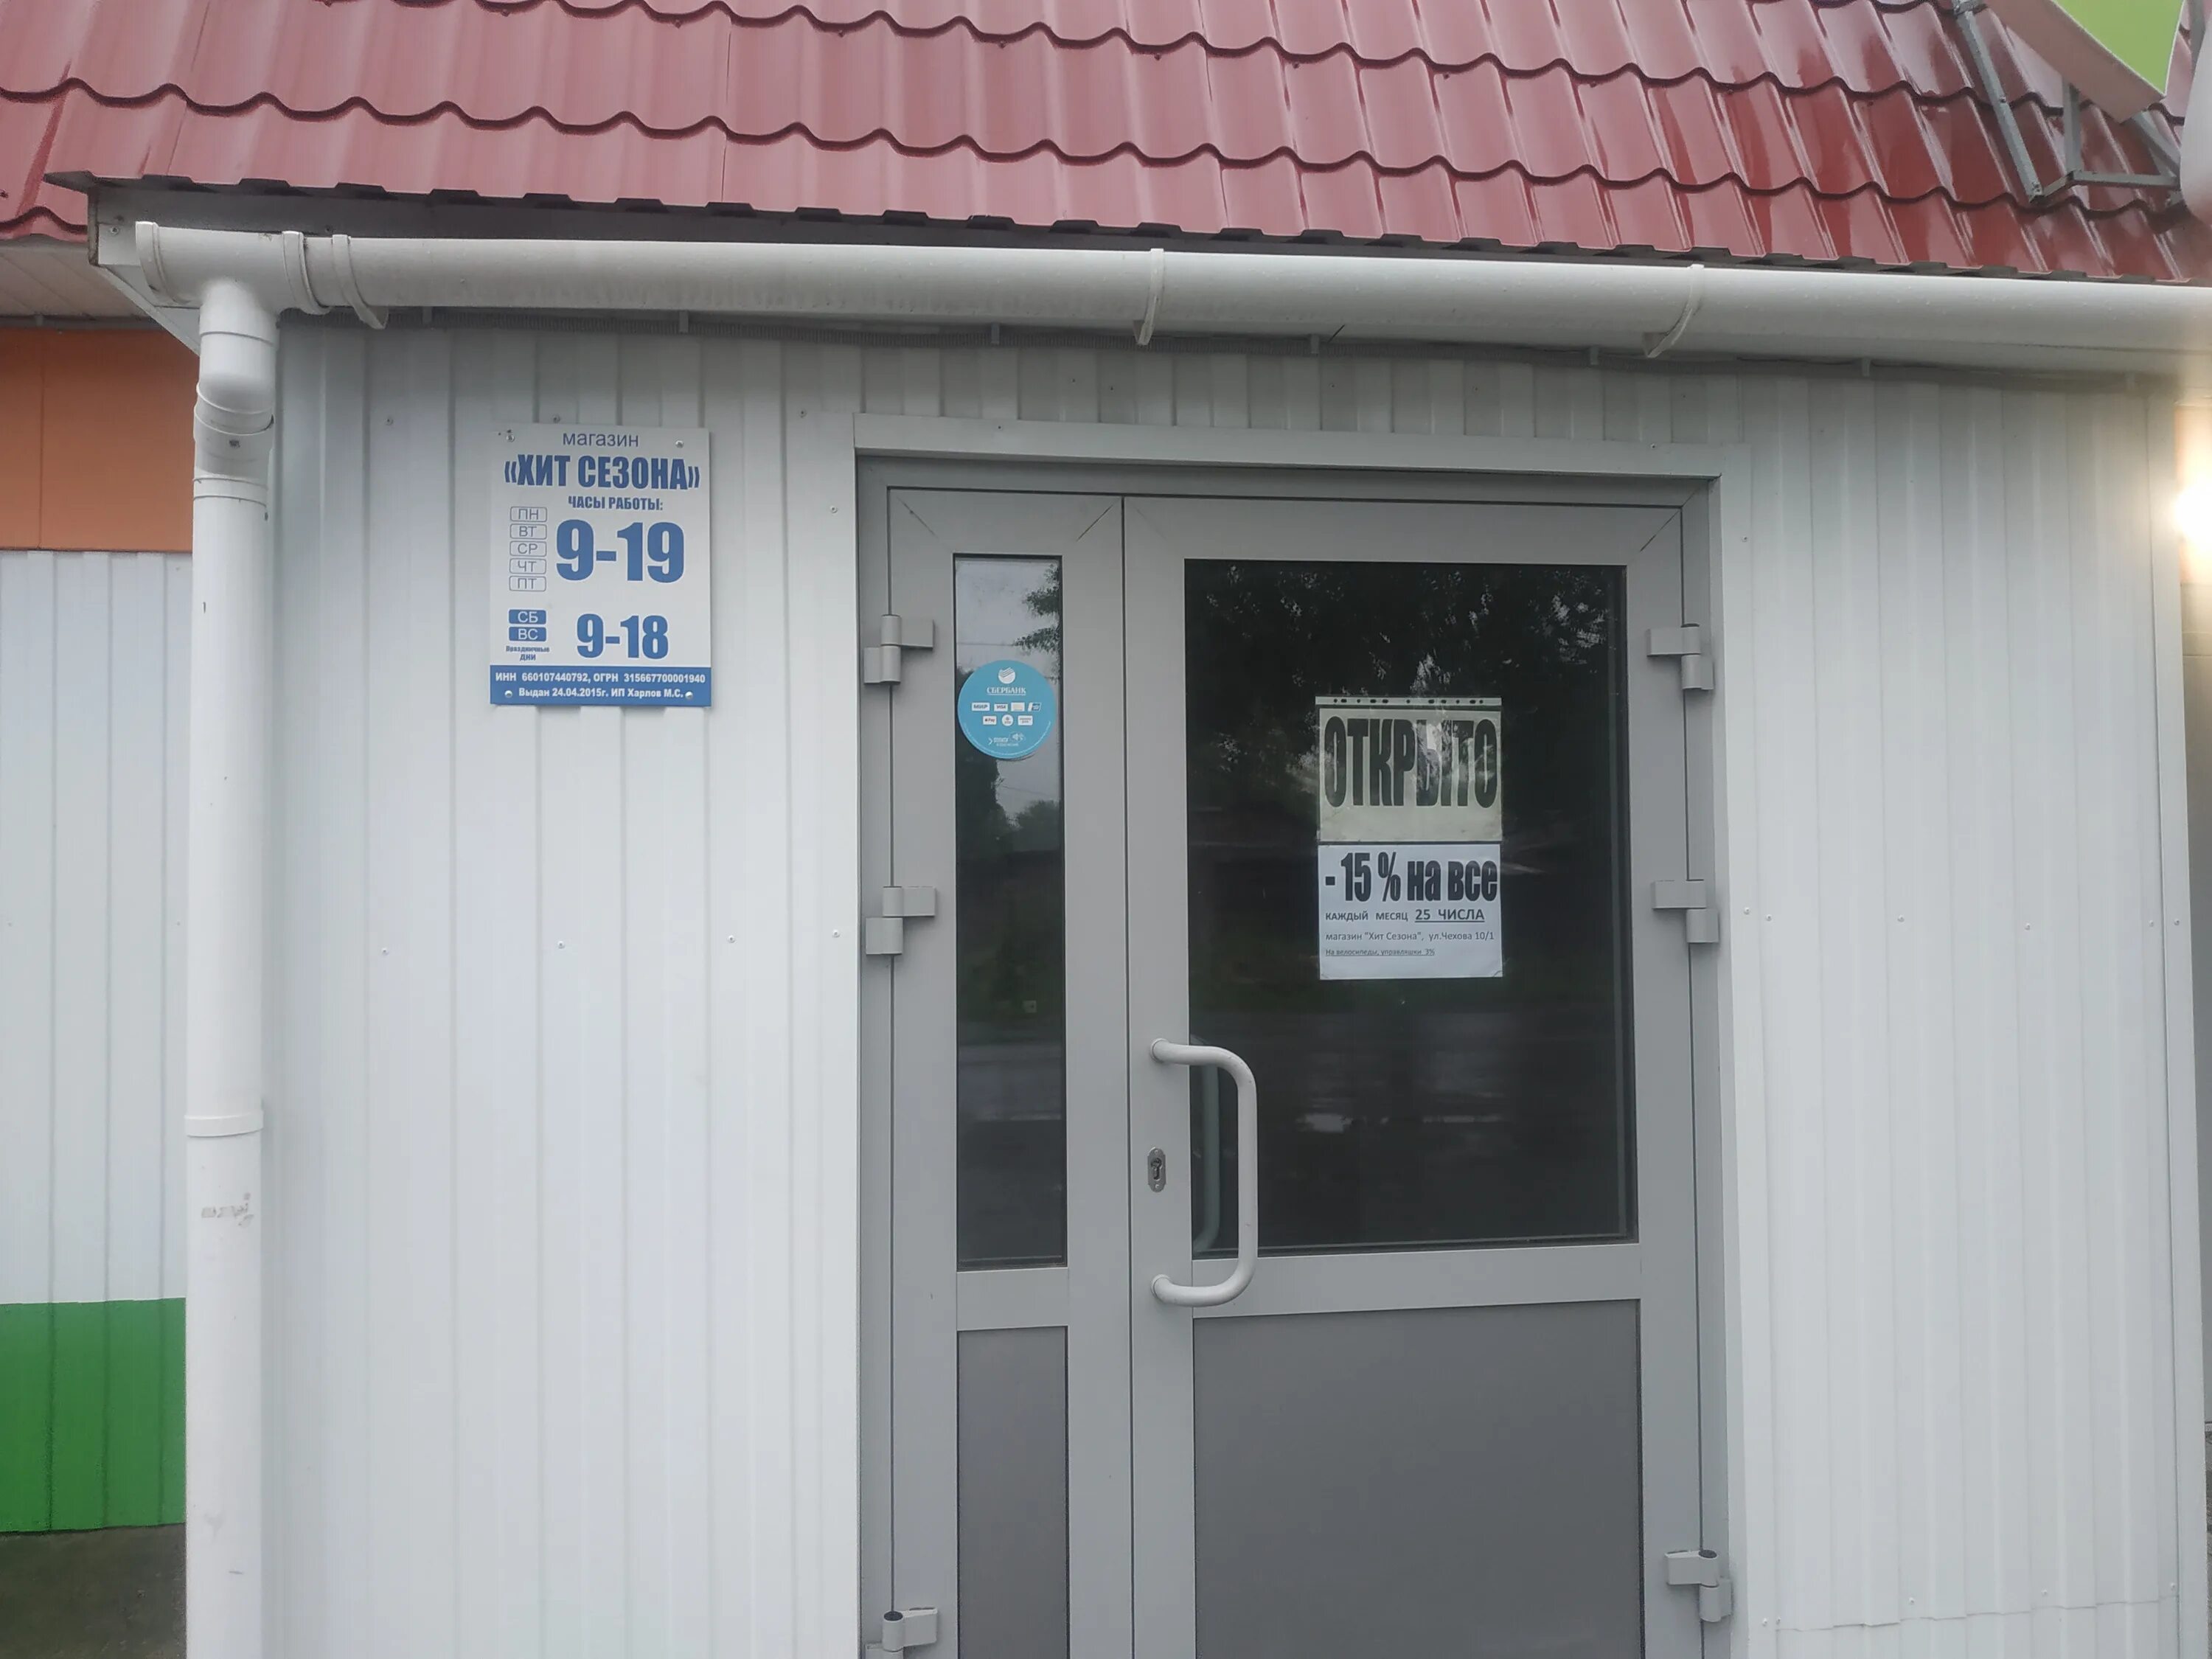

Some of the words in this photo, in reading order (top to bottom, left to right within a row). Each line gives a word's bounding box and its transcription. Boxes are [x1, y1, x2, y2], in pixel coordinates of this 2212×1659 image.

[563, 433, 639, 447] магазин
[504, 454, 570, 486] «ХИТ
[578, 456, 700, 490] СЕЗОНА»
[568, 496, 605, 509] ЧАСЫ
[609, 498, 663, 510] РАБОТЫ:
[518, 509, 538, 520] ПН
[518, 526, 537, 537] ВТ
[517, 543, 538, 554] СР
[556, 519, 684, 583] 9-19
[518, 561, 537, 572] ЧТ
[518, 578, 536, 589] ПТ
[518, 611, 538, 623] СБ
[518, 629, 538, 640] ВС
[577, 613, 668, 659] 9-18
[495, 672, 516, 681] ИНН
[522, 672, 591, 683] 660107440792,
[594, 673, 619, 682] ОГРН
[624, 673, 706, 683] 315667700001940
[518, 688, 549, 698] Выдан
[552, 688, 608, 697] 24.04.2015г.
[611, 689, 625, 697] ИП
[664, 689, 684, 698] М.С.
[1324, 716, 1498, 809] ОТКРЫТО
[1408, 860, 1441, 901] на
[1448, 860, 1498, 902] все
[1326, 911, 1368, 922] КАЖДЫЙ
[1376, 912, 1408, 922] МЕСЯЦ
[1416, 909, 1430, 920] 25
[1439, 909, 1485, 920] ЧИСЛА
[1364, 932, 1384, 940] "Хит
[1475, 931, 1495, 941] 10/1
